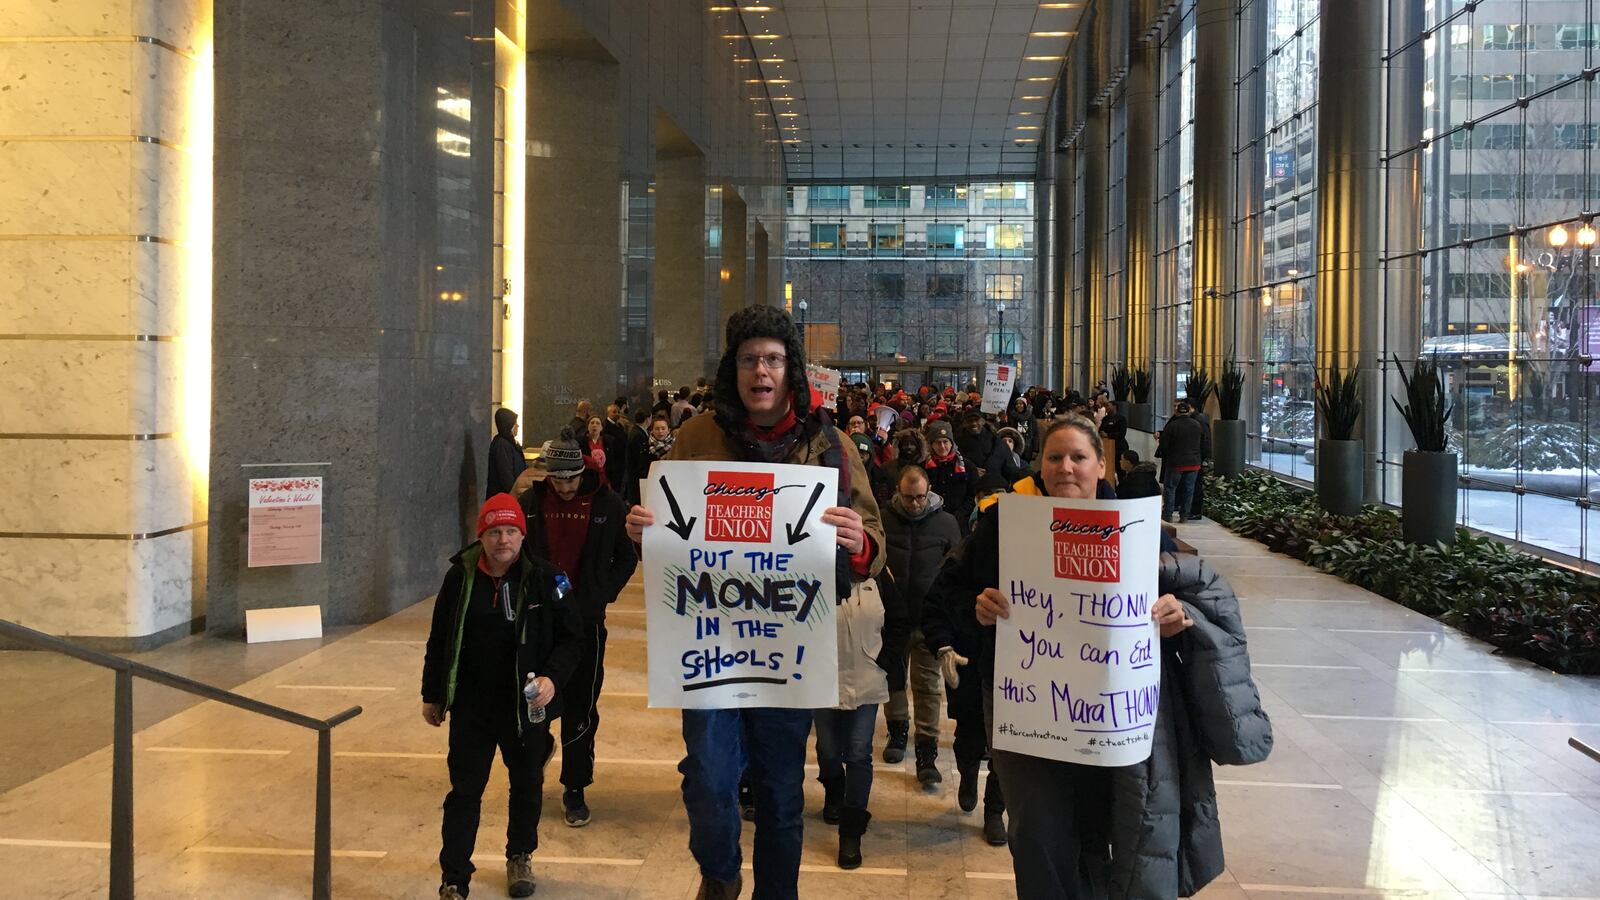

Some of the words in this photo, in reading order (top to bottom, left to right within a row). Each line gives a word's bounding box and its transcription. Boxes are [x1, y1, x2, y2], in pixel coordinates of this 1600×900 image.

[703, 482, 807, 501] Chicago
[707, 504, 772, 519] TEACHERS
[707, 518, 771, 538] UNION
[1050, 519, 1144, 540] Chicago
[690, 548, 734, 572] PUT
[744, 552, 794, 573] THE
[1055, 541, 1119, 559] TEACHERS
[1056, 555, 1117, 578] UNION
[675, 571, 822, 622] MONEY
[1010, 580, 1064, 629] Hey,
[1070, 591, 1148, 620] THONN
[696, 613, 720, 640] IN
[731, 620, 784, 639] THE
[1080, 642, 1119, 665] can
[1129, 637, 1153, 664] End
[998, 676, 1037, 703] this
